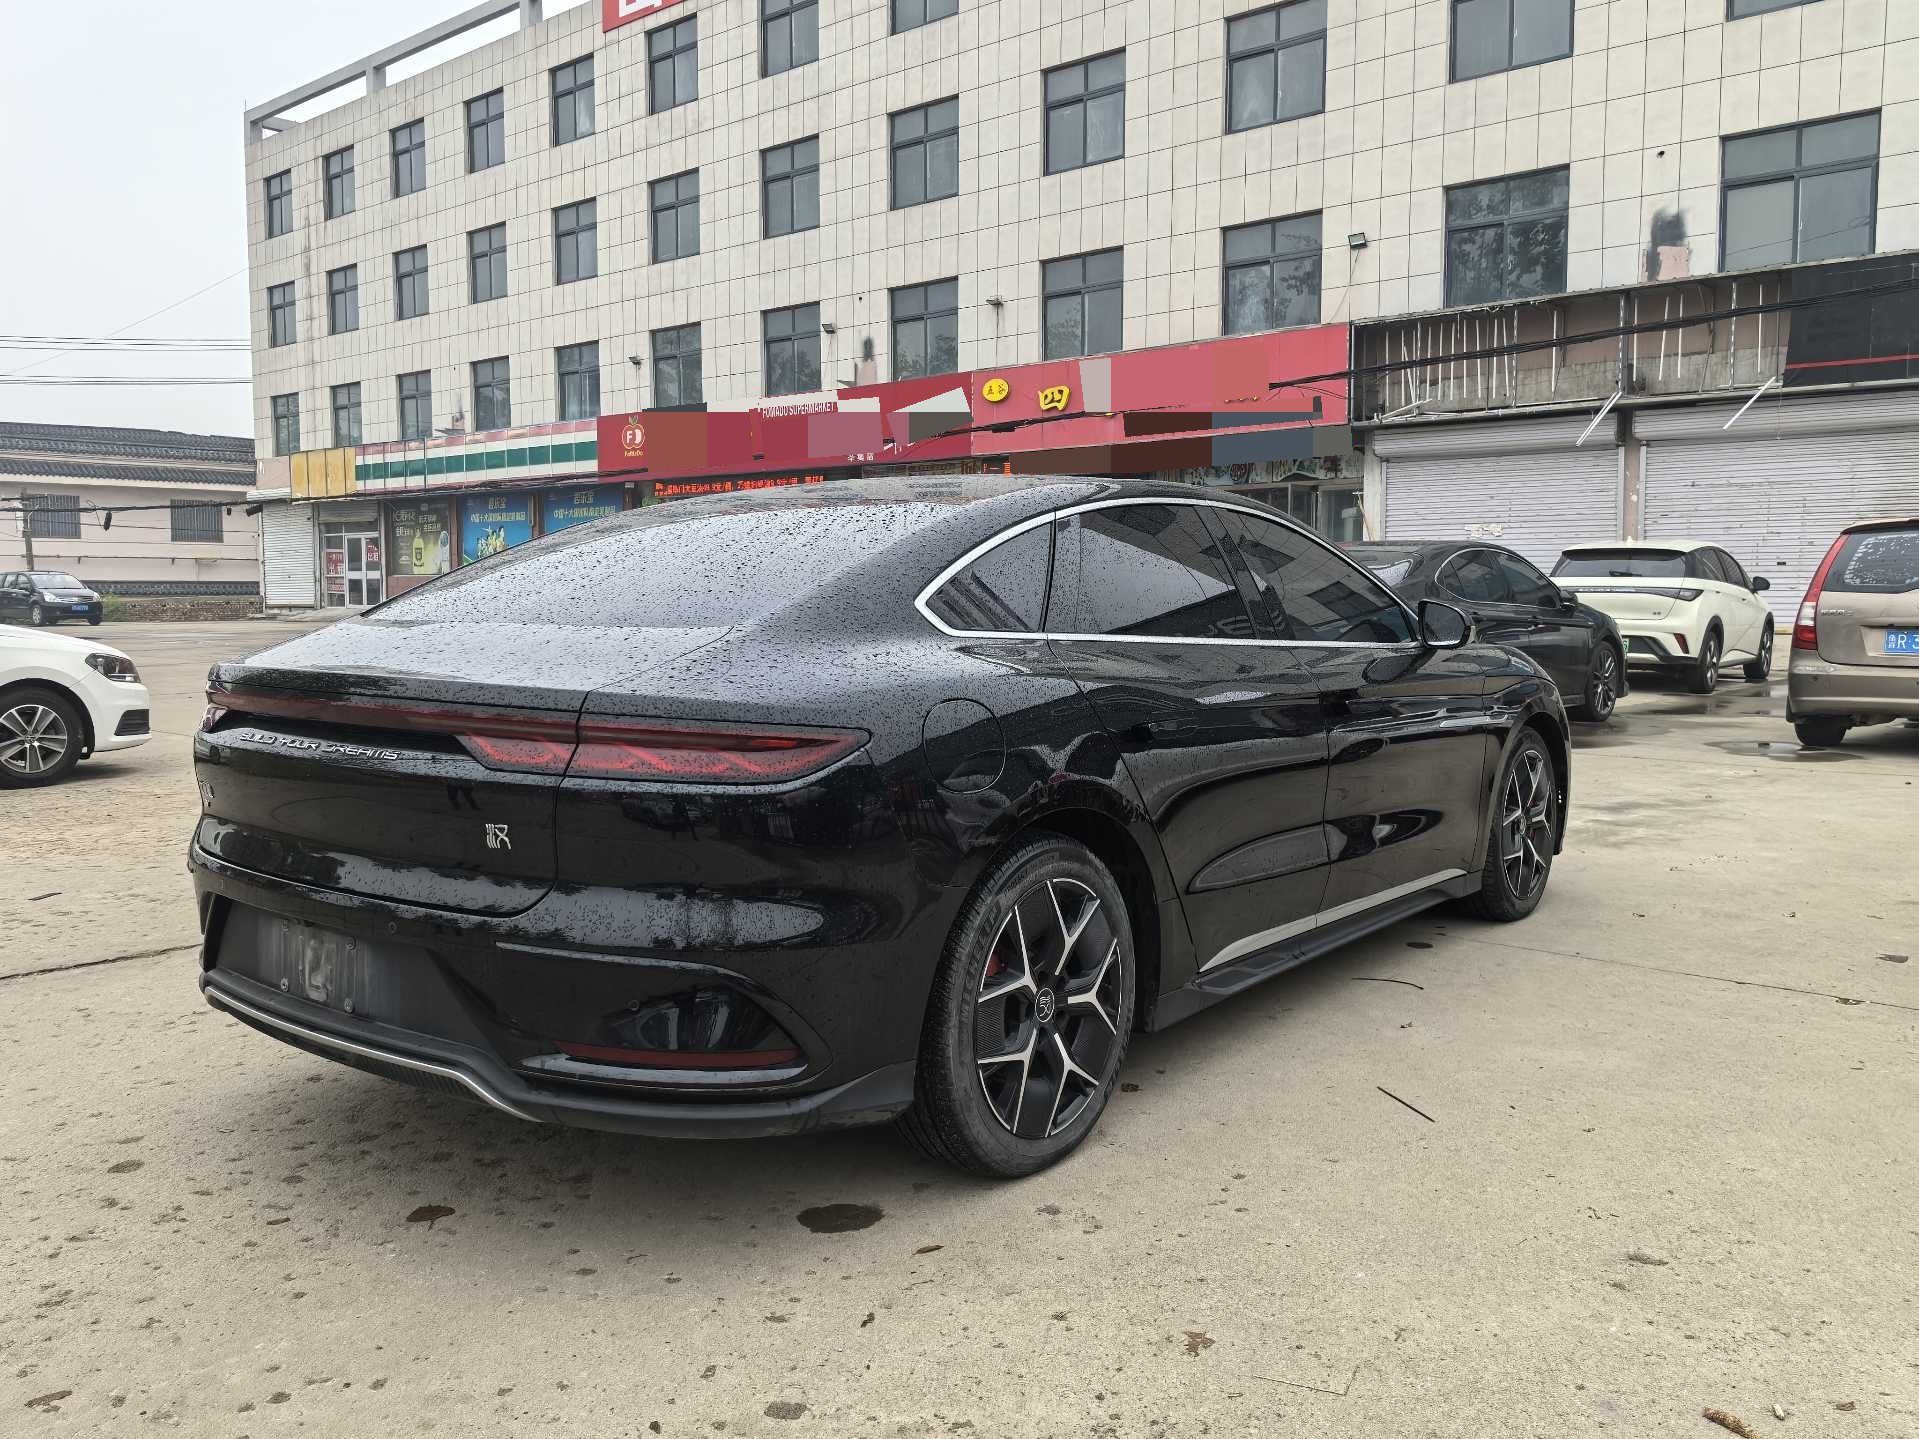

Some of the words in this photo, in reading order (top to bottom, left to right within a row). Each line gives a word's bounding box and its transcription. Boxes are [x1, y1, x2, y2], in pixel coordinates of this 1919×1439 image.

[240, 732, 276, 744] BUILD
[280, 738, 320, 750] YOUR
[322, 743, 400, 760] DREAMS
